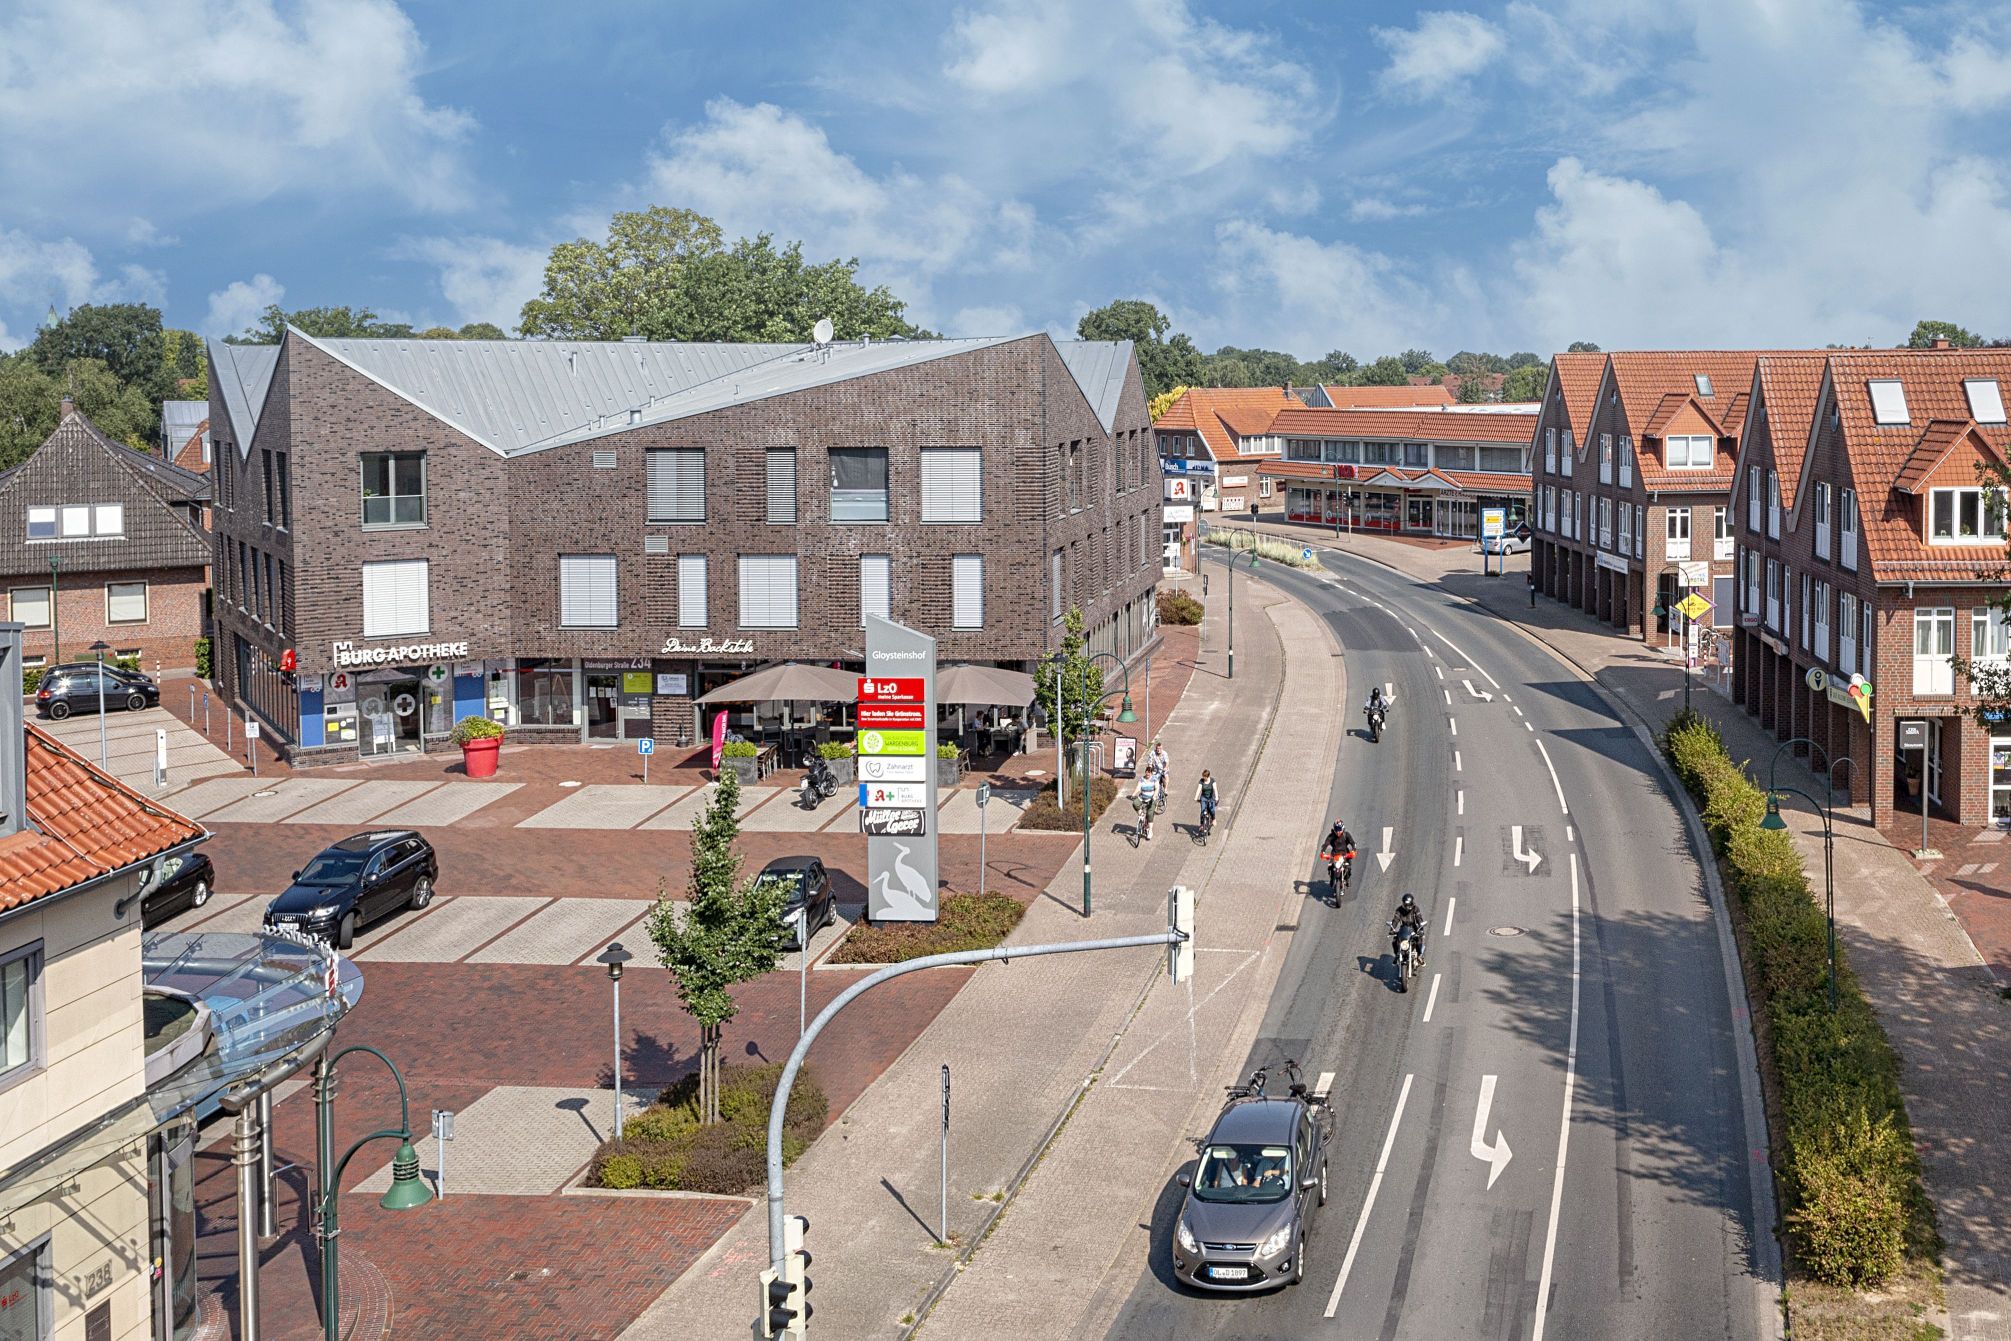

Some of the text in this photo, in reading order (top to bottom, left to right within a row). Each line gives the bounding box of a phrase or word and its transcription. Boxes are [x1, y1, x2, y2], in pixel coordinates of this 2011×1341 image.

[661, 637, 754, 654] Deine Backstube
[872, 650, 927, 661] Gloysteinshof
[584, 657, 652, 669] Oldenburger Straße 234
[877, 682, 898, 694] LzO
[642, 741, 650, 752] P
[89, 1262, 112, 1294] 238
